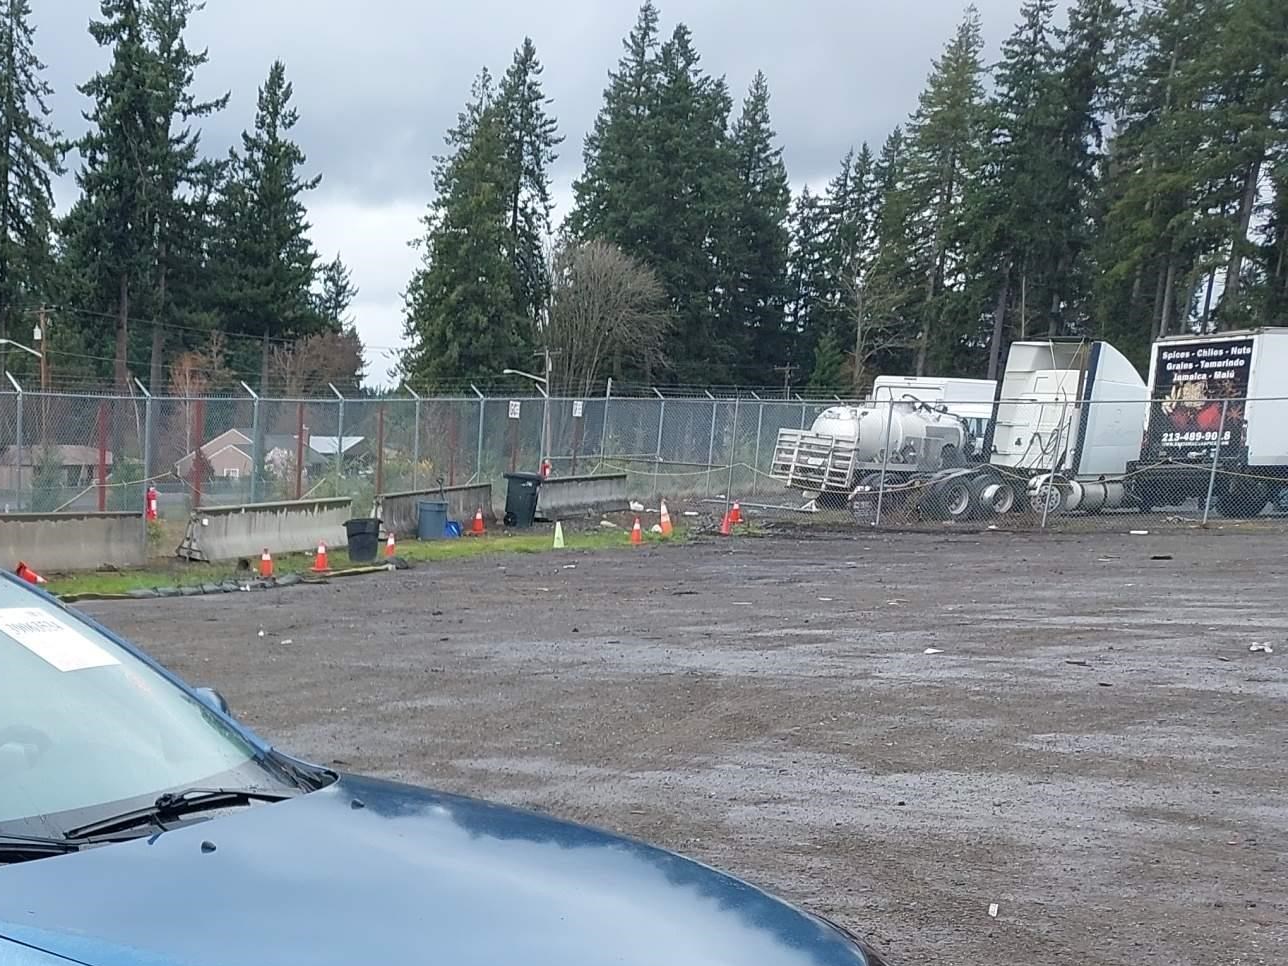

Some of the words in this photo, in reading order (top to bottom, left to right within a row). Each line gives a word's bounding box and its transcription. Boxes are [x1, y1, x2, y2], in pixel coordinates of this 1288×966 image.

[1231, 346, 1251, 355] Nuts
[1166, 362, 1194, 371] Grains
[1200, 358, 1245, 368] Tamarindo
[1173, 371, 1207, 381] Jamaica
[1161, 431, 1231, 442] 213-489-908
